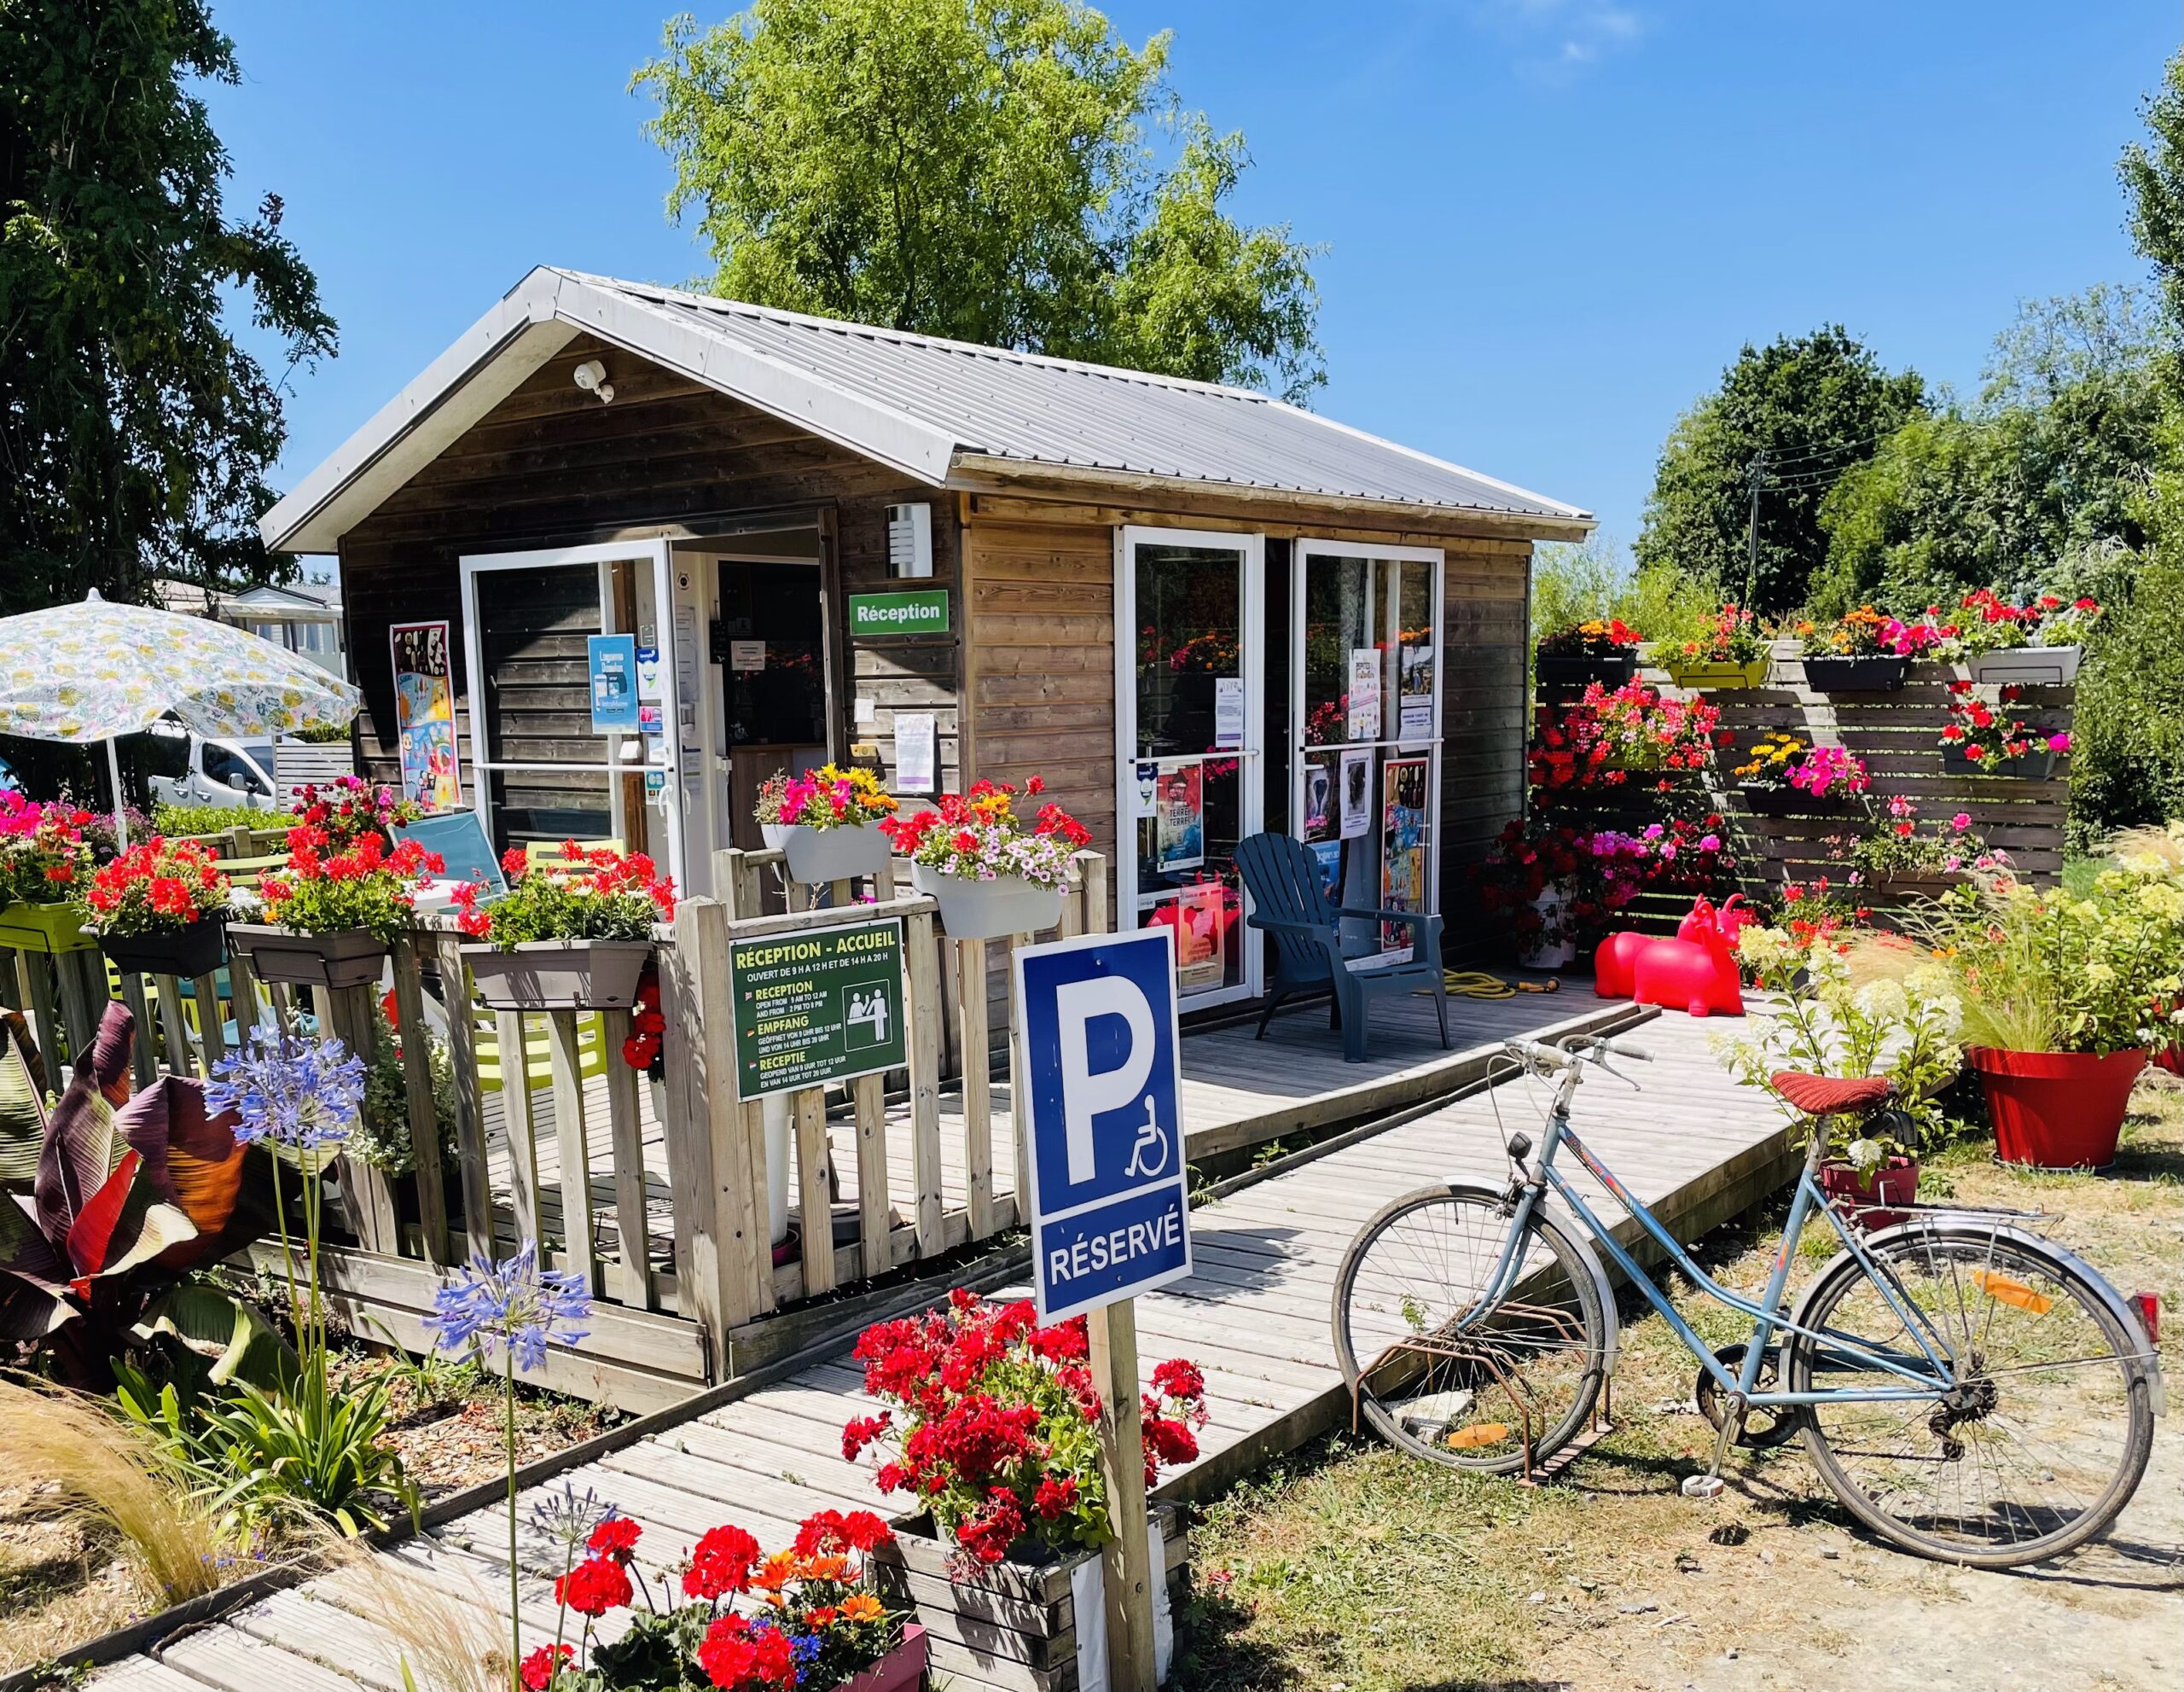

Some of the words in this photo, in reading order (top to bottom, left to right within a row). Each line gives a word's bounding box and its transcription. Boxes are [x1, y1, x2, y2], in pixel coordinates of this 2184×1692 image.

[857, 603, 940, 624] Réception
[736, 941, 821, 969] RÉCEPTION
[836, 931, 896, 953] ACCUEIL
[747, 969, 778, 982] OUVERT
[780, 968, 791, 977] DE
[792, 966, 797, 975] 9
[798, 965, 804, 974] H
[805, 964, 810, 973] A
[812, 962, 821, 972] 12
[822, 962, 828, 970] H
[828, 960, 839, 969] ET
[839, 958, 850, 968] DE
[851, 956, 859, 965] 14
[860, 956, 866, 964] H
[867, 955, 873, 963] A
[873, 953, 881, 962] 20
[882, 952, 888, 961] H
[755, 980, 813, 1001] RECEPTION
[756, 1000, 771, 1009] OPEN
[772, 997, 787, 1007] FROM
[756, 1009, 769, 1019] AND
[769, 1007, 785, 1016] FROM
[758, 1015, 810, 1035] EMPFANG
[758, 1033, 787, 1045] GEÖFFNET
[787, 1032, 799, 1040] VON
[803, 1028, 814, 1037] UHR
[830, 1022, 842, 1032] UHR
[758, 1045, 770, 1055] UND
[771, 1043, 782, 1052] VON
[790, 1039, 802, 1048] UHR
[802, 1038, 811, 1046] BIS
[818, 1034, 829, 1043] UHR
[759, 1051, 806, 1071] RECEPTIE
[759, 1068, 787, 1080] GEOPEND
[787, 1066, 799, 1074] VAN
[804, 1062, 816, 1071] UUR
[816, 1060, 827, 1068] TOT
[834, 1055, 846, 1064] UUR
[760, 1080, 769, 1089] EN
[769, 1078, 781, 1086] VAN
[788, 1073, 801, 1083] UUR
[801, 1071, 812, 1079] TOT
[1056, 975, 1155, 1185] P
[1049, 1203, 1181, 1286] RÉSERVÉ
